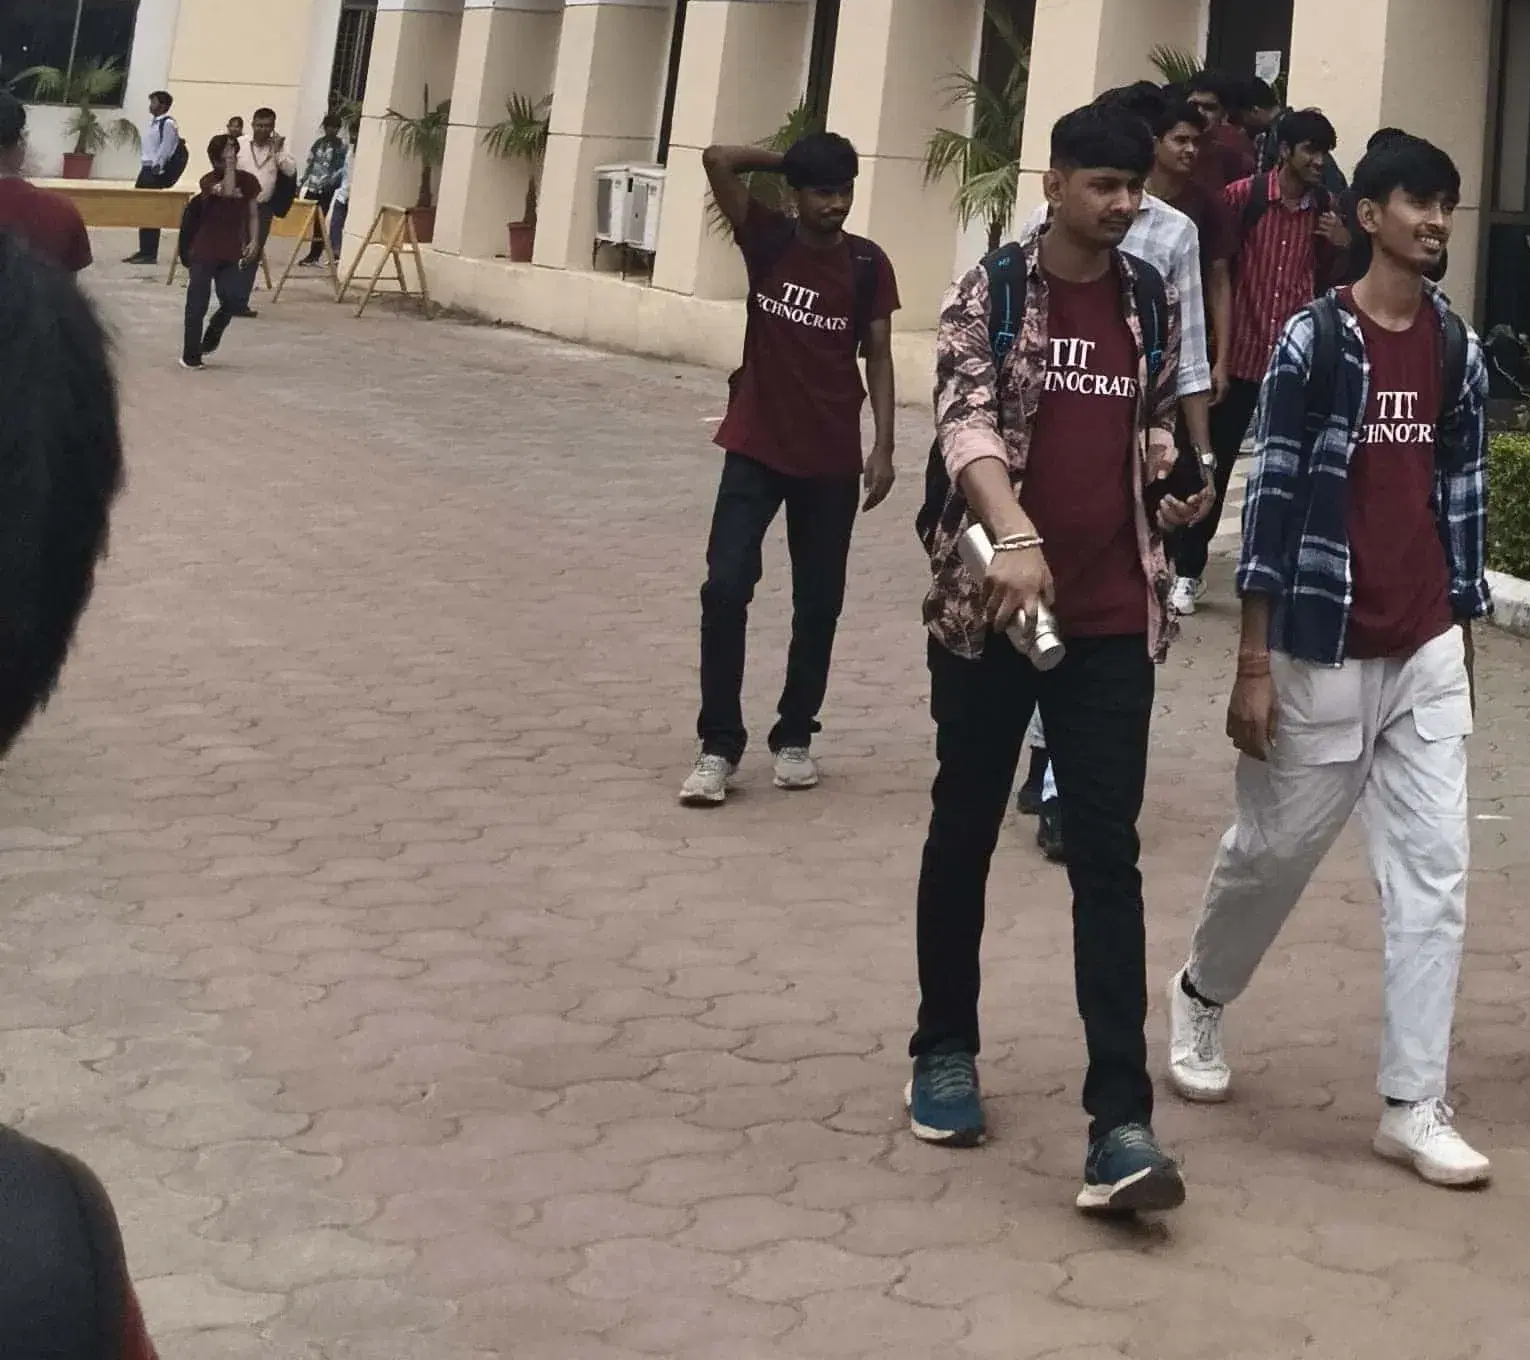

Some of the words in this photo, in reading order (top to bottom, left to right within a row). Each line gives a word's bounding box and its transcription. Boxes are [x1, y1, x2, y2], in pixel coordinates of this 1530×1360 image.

[782, 282, 820, 310] TIT
[1050, 337, 1096, 369] TIT
[1377, 391, 1418, 420] TIT
